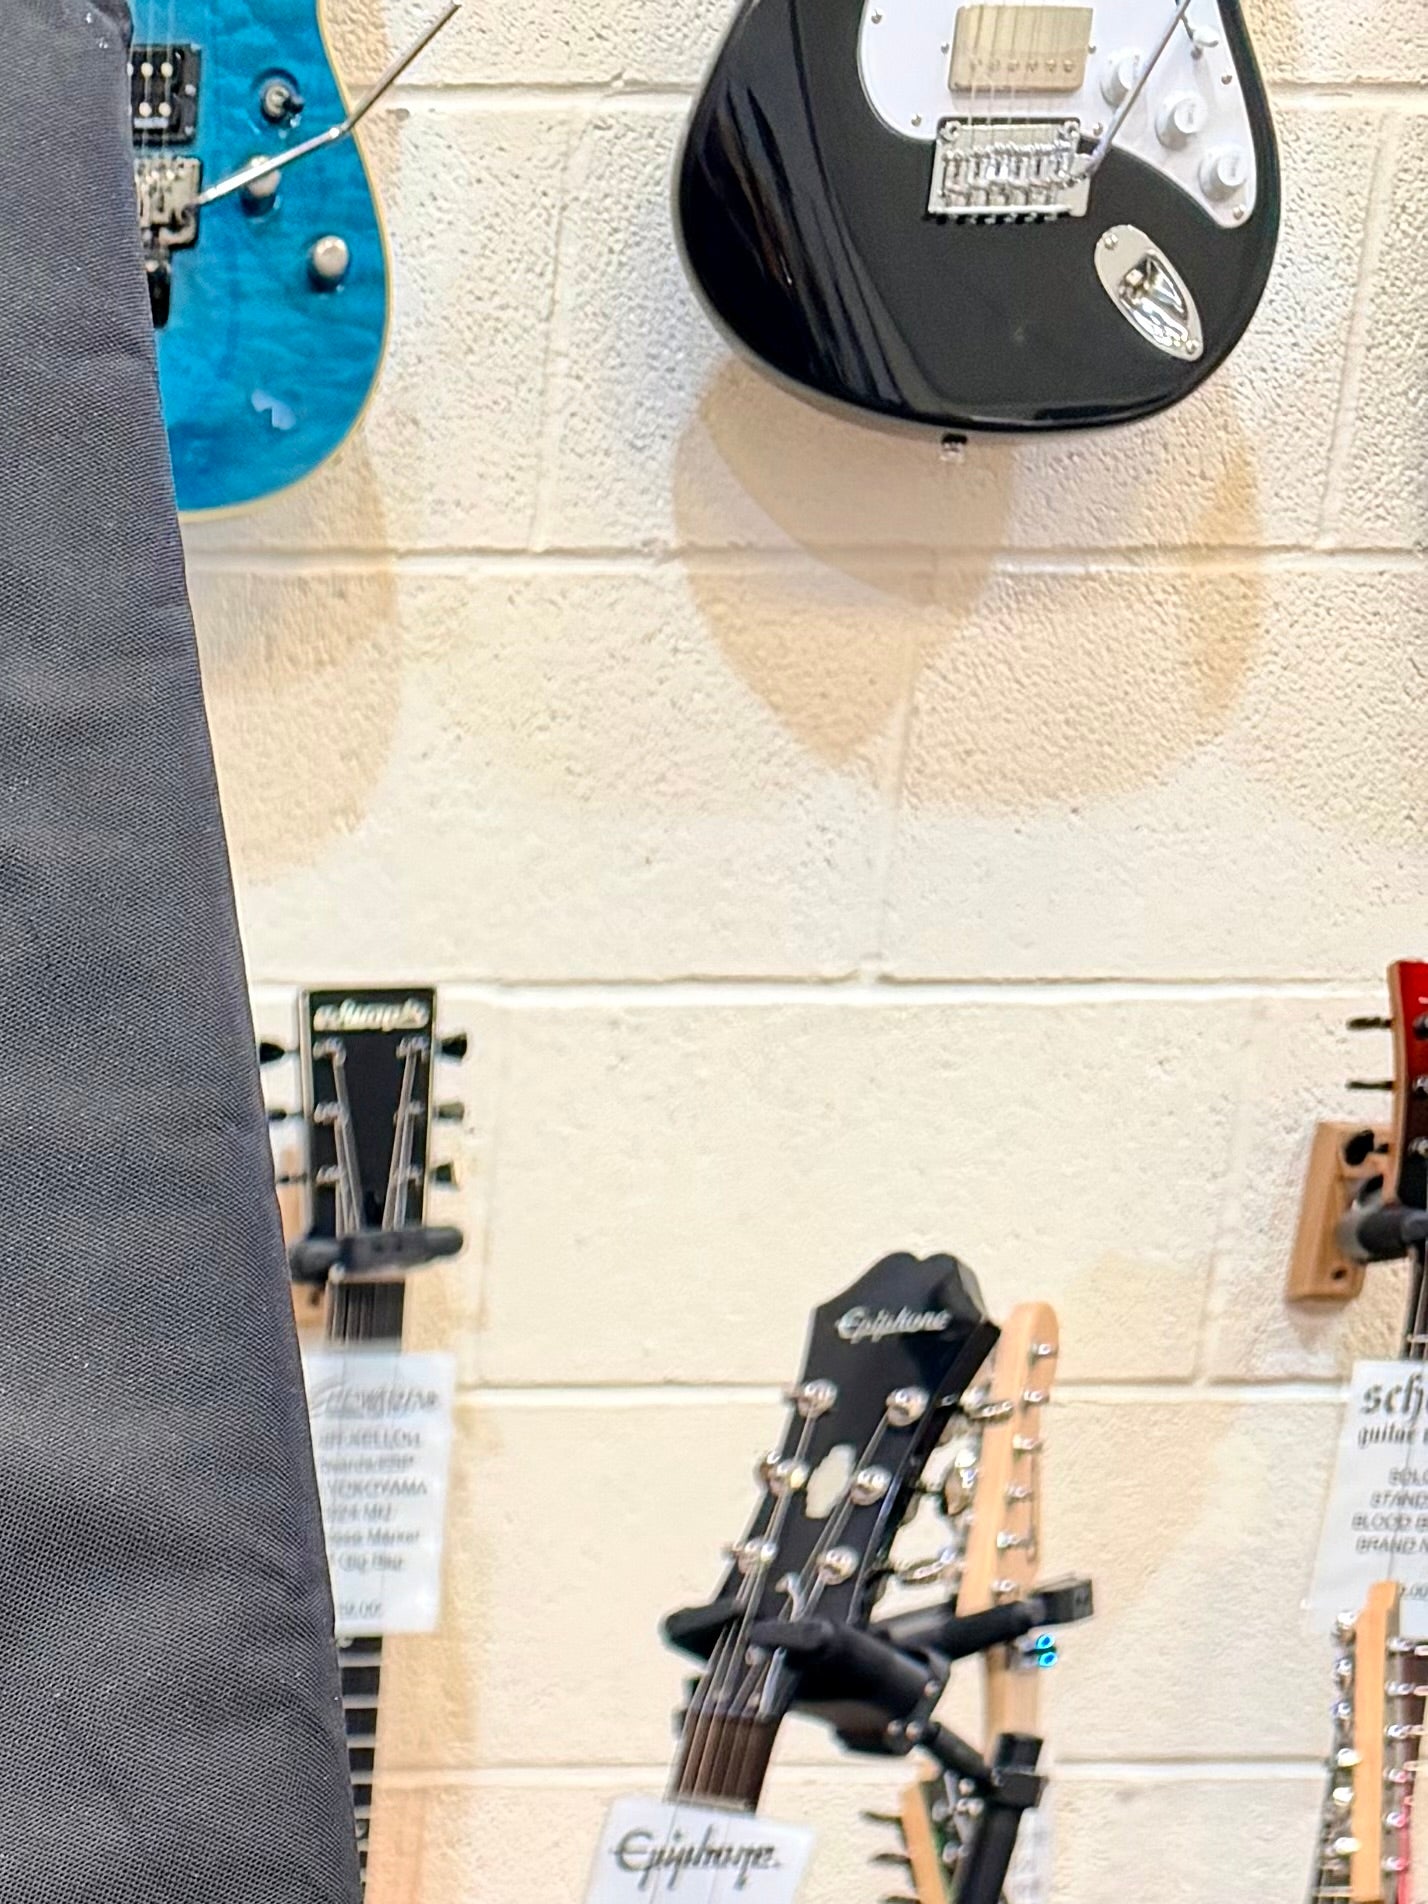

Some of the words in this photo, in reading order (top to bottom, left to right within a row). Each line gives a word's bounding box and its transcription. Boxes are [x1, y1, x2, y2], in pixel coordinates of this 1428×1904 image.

[834, 1305, 954, 1344] Epiphone
[1360, 1372, 1428, 1419] sch
[608, 1824, 782, 1891] Epiphone
